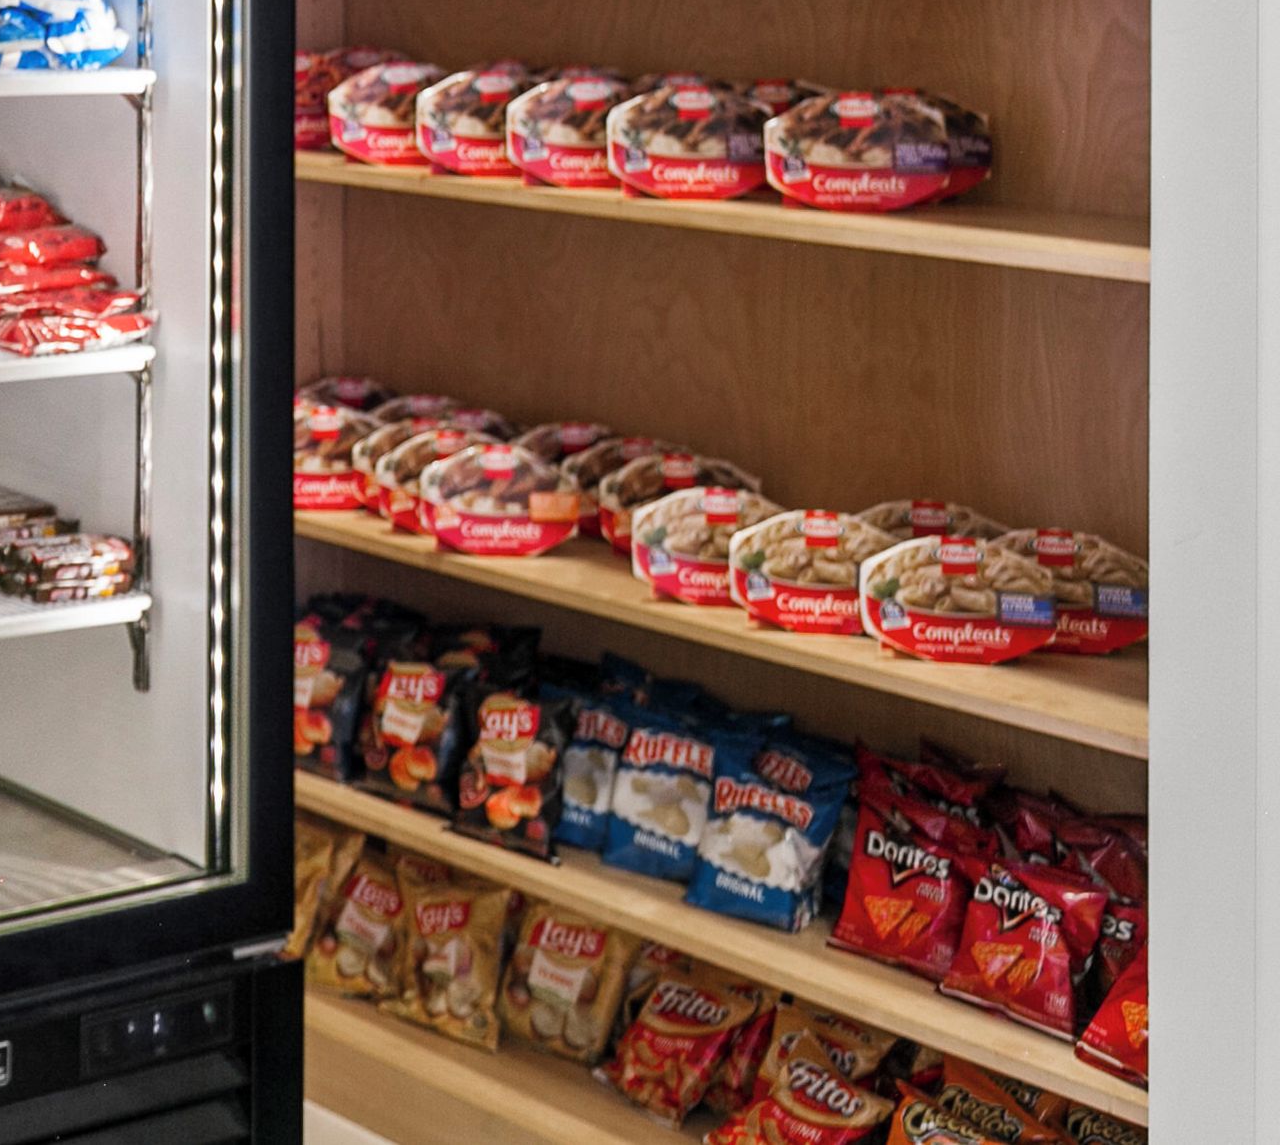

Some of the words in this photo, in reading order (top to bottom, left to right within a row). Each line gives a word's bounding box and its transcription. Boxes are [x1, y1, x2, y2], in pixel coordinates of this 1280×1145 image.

[812, 172, 907, 197] Compleats
[912, 620, 1011, 646] Compleats
[714, 776, 815, 830] RUFFLES
[867, 830, 951, 879] Doritos
[716, 871, 766, 905] ORIGINAL
[973, 877, 1063, 924] Doritos
[540, 917, 601, 957] Lay's
[649, 981, 729, 1026] Fritos
[790, 1057, 864, 1118] Fritos
